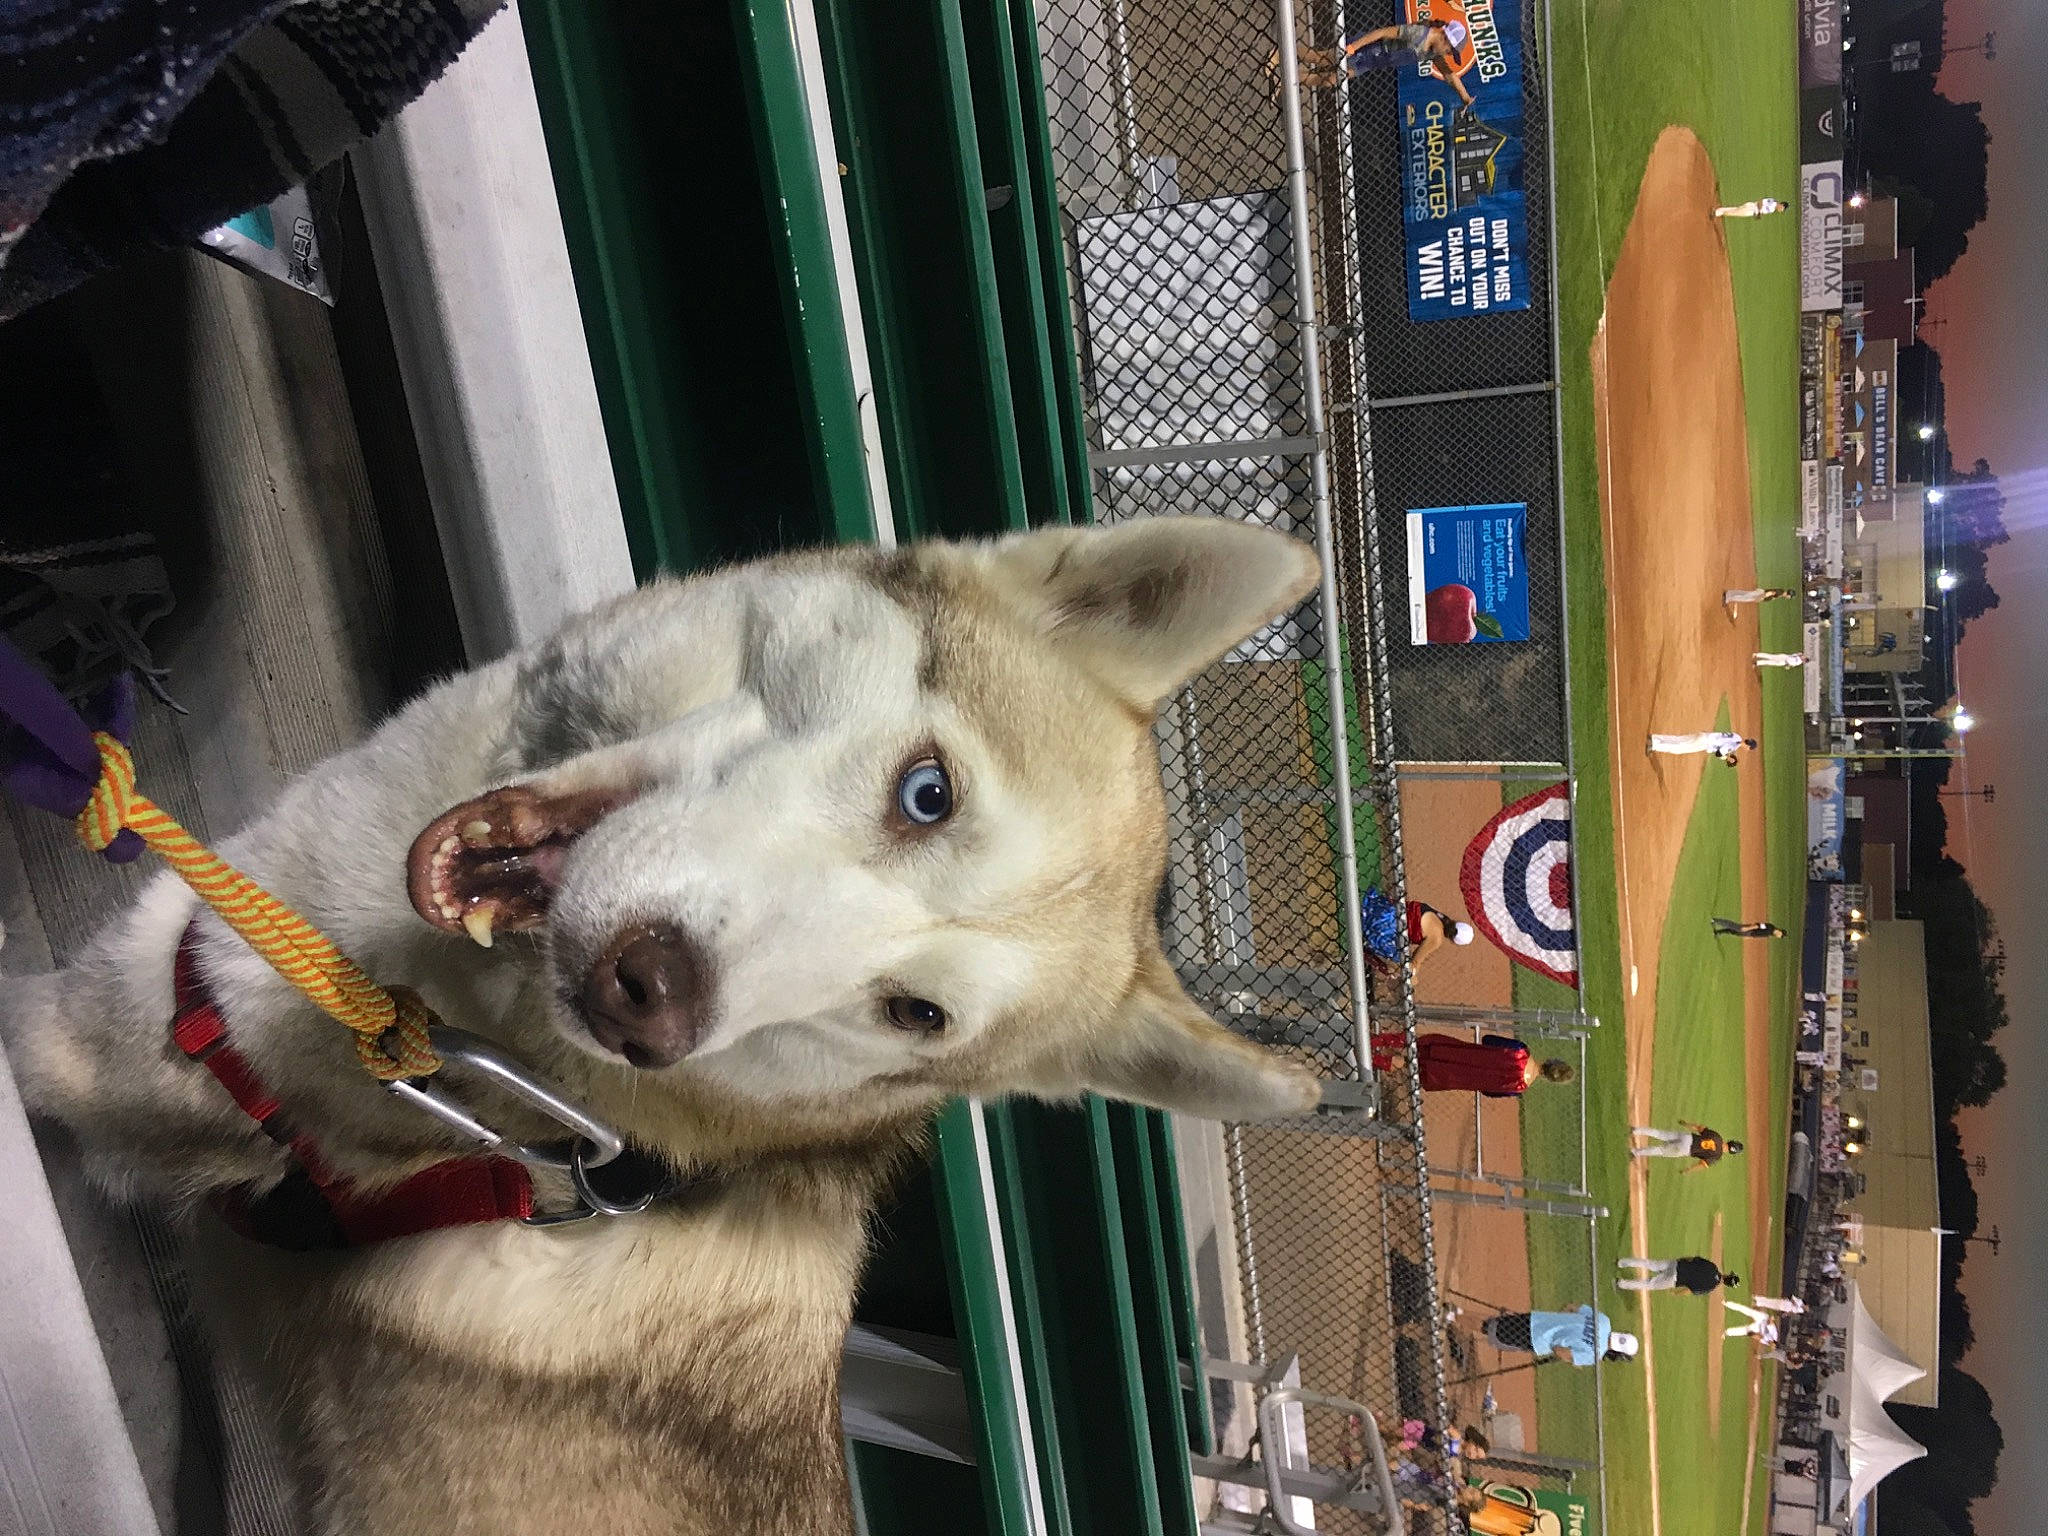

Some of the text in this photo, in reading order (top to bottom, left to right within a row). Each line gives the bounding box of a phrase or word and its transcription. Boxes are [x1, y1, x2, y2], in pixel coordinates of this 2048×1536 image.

[1411, 128, 1428, 222] EXTERIORS
[1425, 101, 1448, 219] CHARACTER
[1418, 240, 1445, 300] WIN!
[1447, 227, 1467, 306] CHANCE TO
[1469, 217, 1488, 310] OUT ON YOUR
[1492, 219, 1511, 302] DON'T MISS
[1809, 216, 1822, 298] COMFORT
[1824, 213, 1842, 295] CLIMAX
[1875, 387, 1887, 423] BELL'S
[1875, 427, 1887, 454] BEAR
[1875, 457, 1887, 485] CAVE
[1428, 523, 1436, 555] uhc.com
[1481, 519, 1496, 613] and vegetables!
[1494, 519, 1508, 602] Eat your fruits
[1822, 803, 1837, 840] MILK
